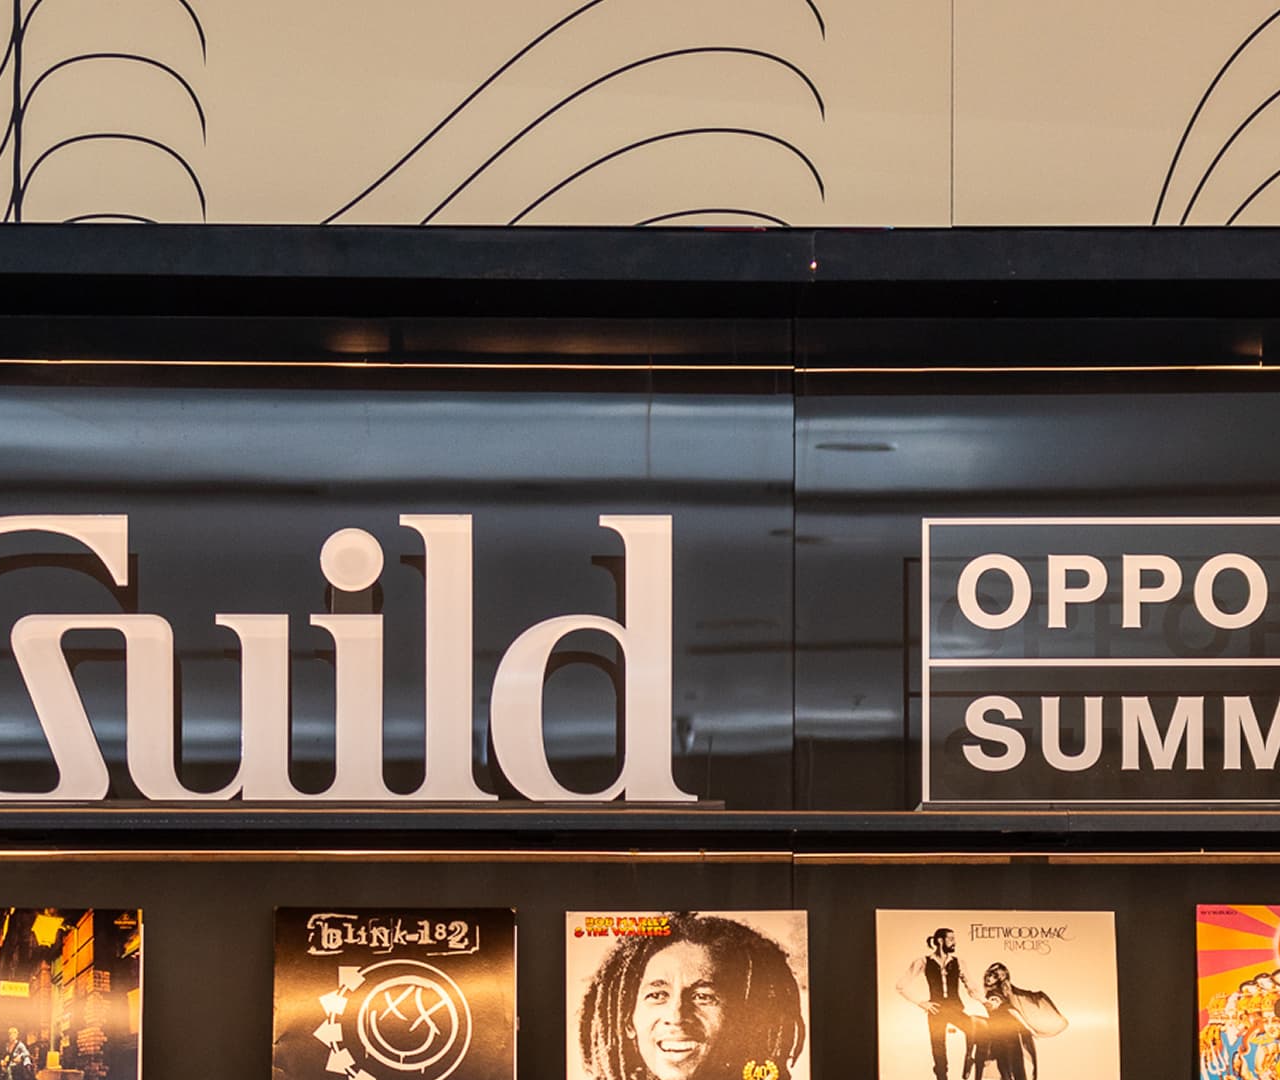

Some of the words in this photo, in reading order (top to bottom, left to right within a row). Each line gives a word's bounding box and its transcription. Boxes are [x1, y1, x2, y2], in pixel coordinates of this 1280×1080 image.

[585, 917, 614, 927] BOB
[616, 917, 669, 927] MARLEY
[586, 928, 609, 937] THE
[970, 923, 1039, 940] FLEETWOOD
[1003, 940, 1052, 955] RUMOURS
